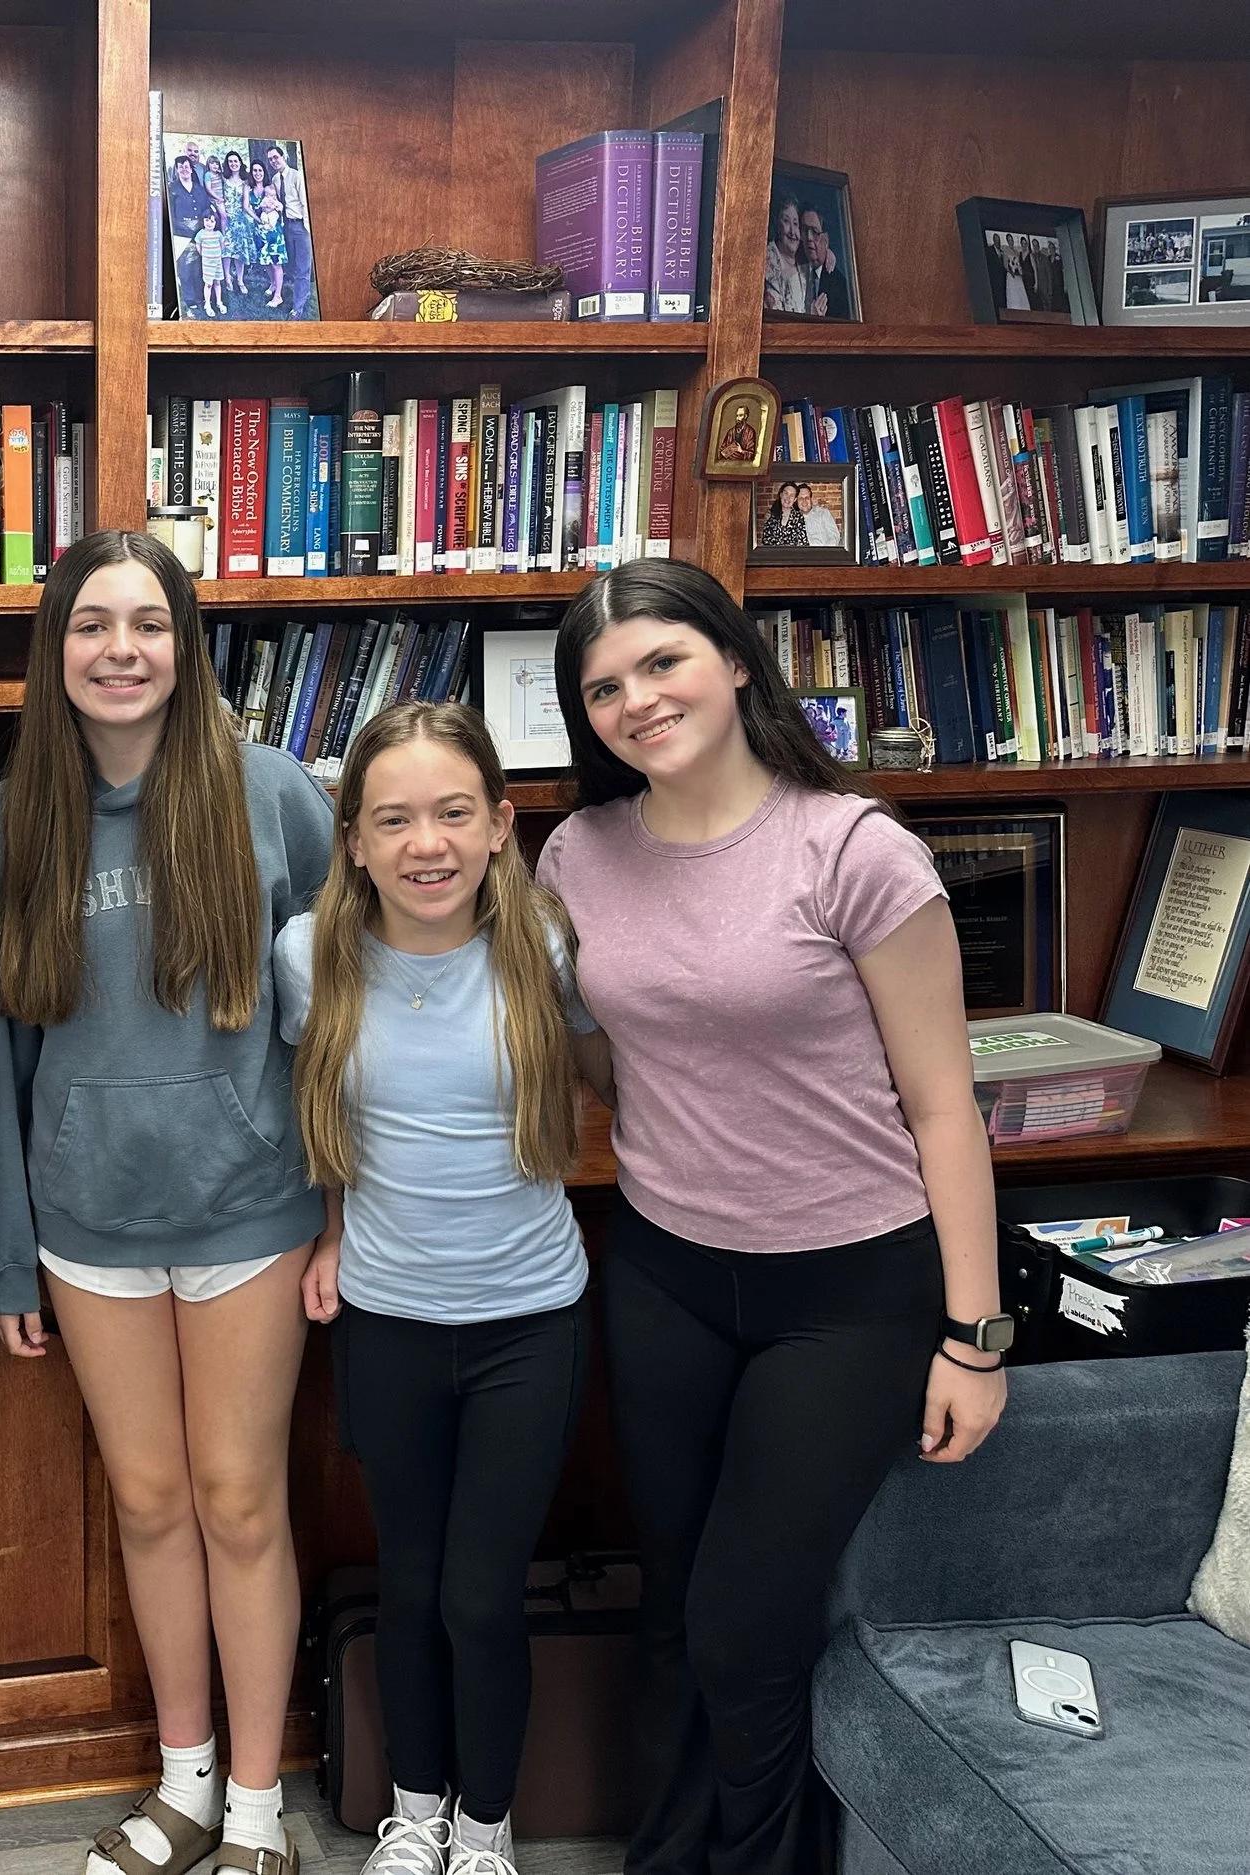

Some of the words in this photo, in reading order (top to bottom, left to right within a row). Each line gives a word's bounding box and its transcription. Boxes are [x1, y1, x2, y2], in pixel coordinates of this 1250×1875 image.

[615, 166, 629, 279] DICTIONARY
[665, 166, 680, 279] DICTIONARY
[630, 226, 643, 277] BIBLE
[679, 227, 692, 278] BIBLE
[481, 392, 501, 400] ALICE
[481, 401, 501, 409] BACH
[247, 407, 261, 436] The
[456, 403, 468, 433] SPONG
[546, 411, 556, 435] BAD
[1134, 412, 1144, 432] TEXT
[172, 439, 184, 469] THE
[231, 408, 246, 481] Annotated
[246, 438, 259, 469] New
[282, 428, 294, 462] BIBLE
[484, 417, 495, 462] WOMEN
[545, 435, 555, 465] GIRLS
[1108, 431, 1122, 476] Systematic
[1135, 434, 1145, 452] AND
[1207, 407, 1217, 477] CHRISTIANITY
[1218, 406, 1227, 481] ENCYCLOPEDIA
[454, 455, 468, 481] SINS
[605, 447, 613, 464] THE
[652, 436, 665, 492] SCRIPTURE
[663, 438, 674, 480] WOMEN
[928, 444, 941, 497] CRUCIFIED
[931, 442, 945, 485] APOSTLE
[978, 433, 993, 487] GALATIANS
[1137, 454, 1147, 482] TRUTH
[61, 466, 70, 490] God's
[172, 472, 185, 504] GOO
[194, 478, 217, 491] BIBLE
[543, 473, 553, 502] BIBLE
[604, 465, 613, 483] OLD
[864, 458, 875, 491] LETTERS
[229, 485, 243, 520] Bible
[244, 470, 258, 520] Oxford
[291, 450, 302, 532] HARPERCOLLINS
[308, 490, 318, 513] Bible
[482, 481, 493, 520] HEBREW
[603, 484, 612, 528] TESTAMENT
[61, 492, 72, 537] Secretaries
[279, 465, 293, 553] COMMENTARY
[451, 491, 467, 548] SCRIPTURE
[1075, 495, 1087, 542] THEOLOGY
[1139, 495, 1149, 524] WATSON
[312, 527, 321, 549] LANG
[481, 521, 491, 544] BIBLE
[541, 522, 551, 550] HIGGS
[779, 615, 789, 643] MATERA
[310, 653, 320, 675] GOSPEL
[780, 648, 789, 663] NEW
[836, 645, 847, 678] JESUS
[990, 662, 999, 677] Why
[412, 676, 422, 687] the
[894, 662, 904, 686] Mystery
[276, 685, 291, 724] COMMENTARY
[303, 685, 313, 708] LETTERS
[330, 680, 344, 711] PALESTINE
[873, 678, 881, 707] KILLED
[993, 679, 1003, 722] CHRISTIAN?
[297, 714, 306, 731] JOHN
[319, 740, 329, 758] JESUS
[1183, 839, 1226, 858] LUTHER
[1070, 1309, 1096, 1326] abiding
